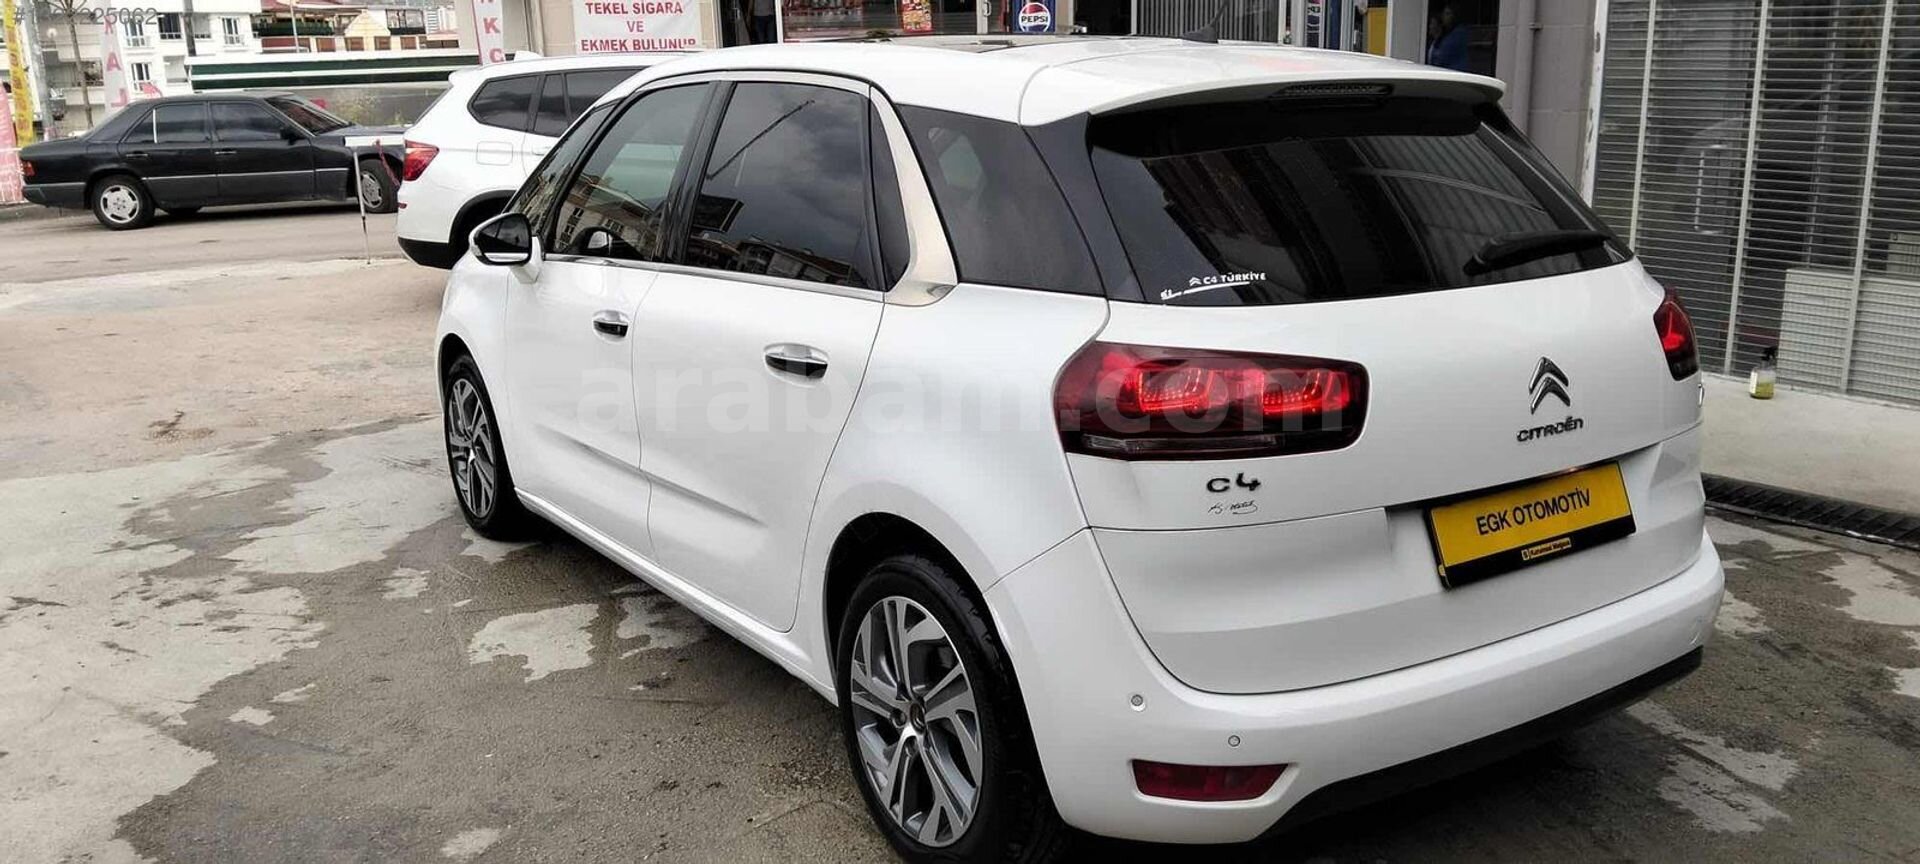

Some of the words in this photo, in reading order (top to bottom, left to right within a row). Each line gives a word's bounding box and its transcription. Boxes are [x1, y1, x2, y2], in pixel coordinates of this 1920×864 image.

[585, 2, 629, 15] TEKEL
[1021, 11, 1048, 23] PEPSI
[626, 20, 644, 33] VE
[580, 39, 629, 52] EKMEK
[1206, 472, 1262, 493] C4
[1475, 511, 1515, 536] EGK
[1512, 487, 1592, 526] OTOMOTİV
